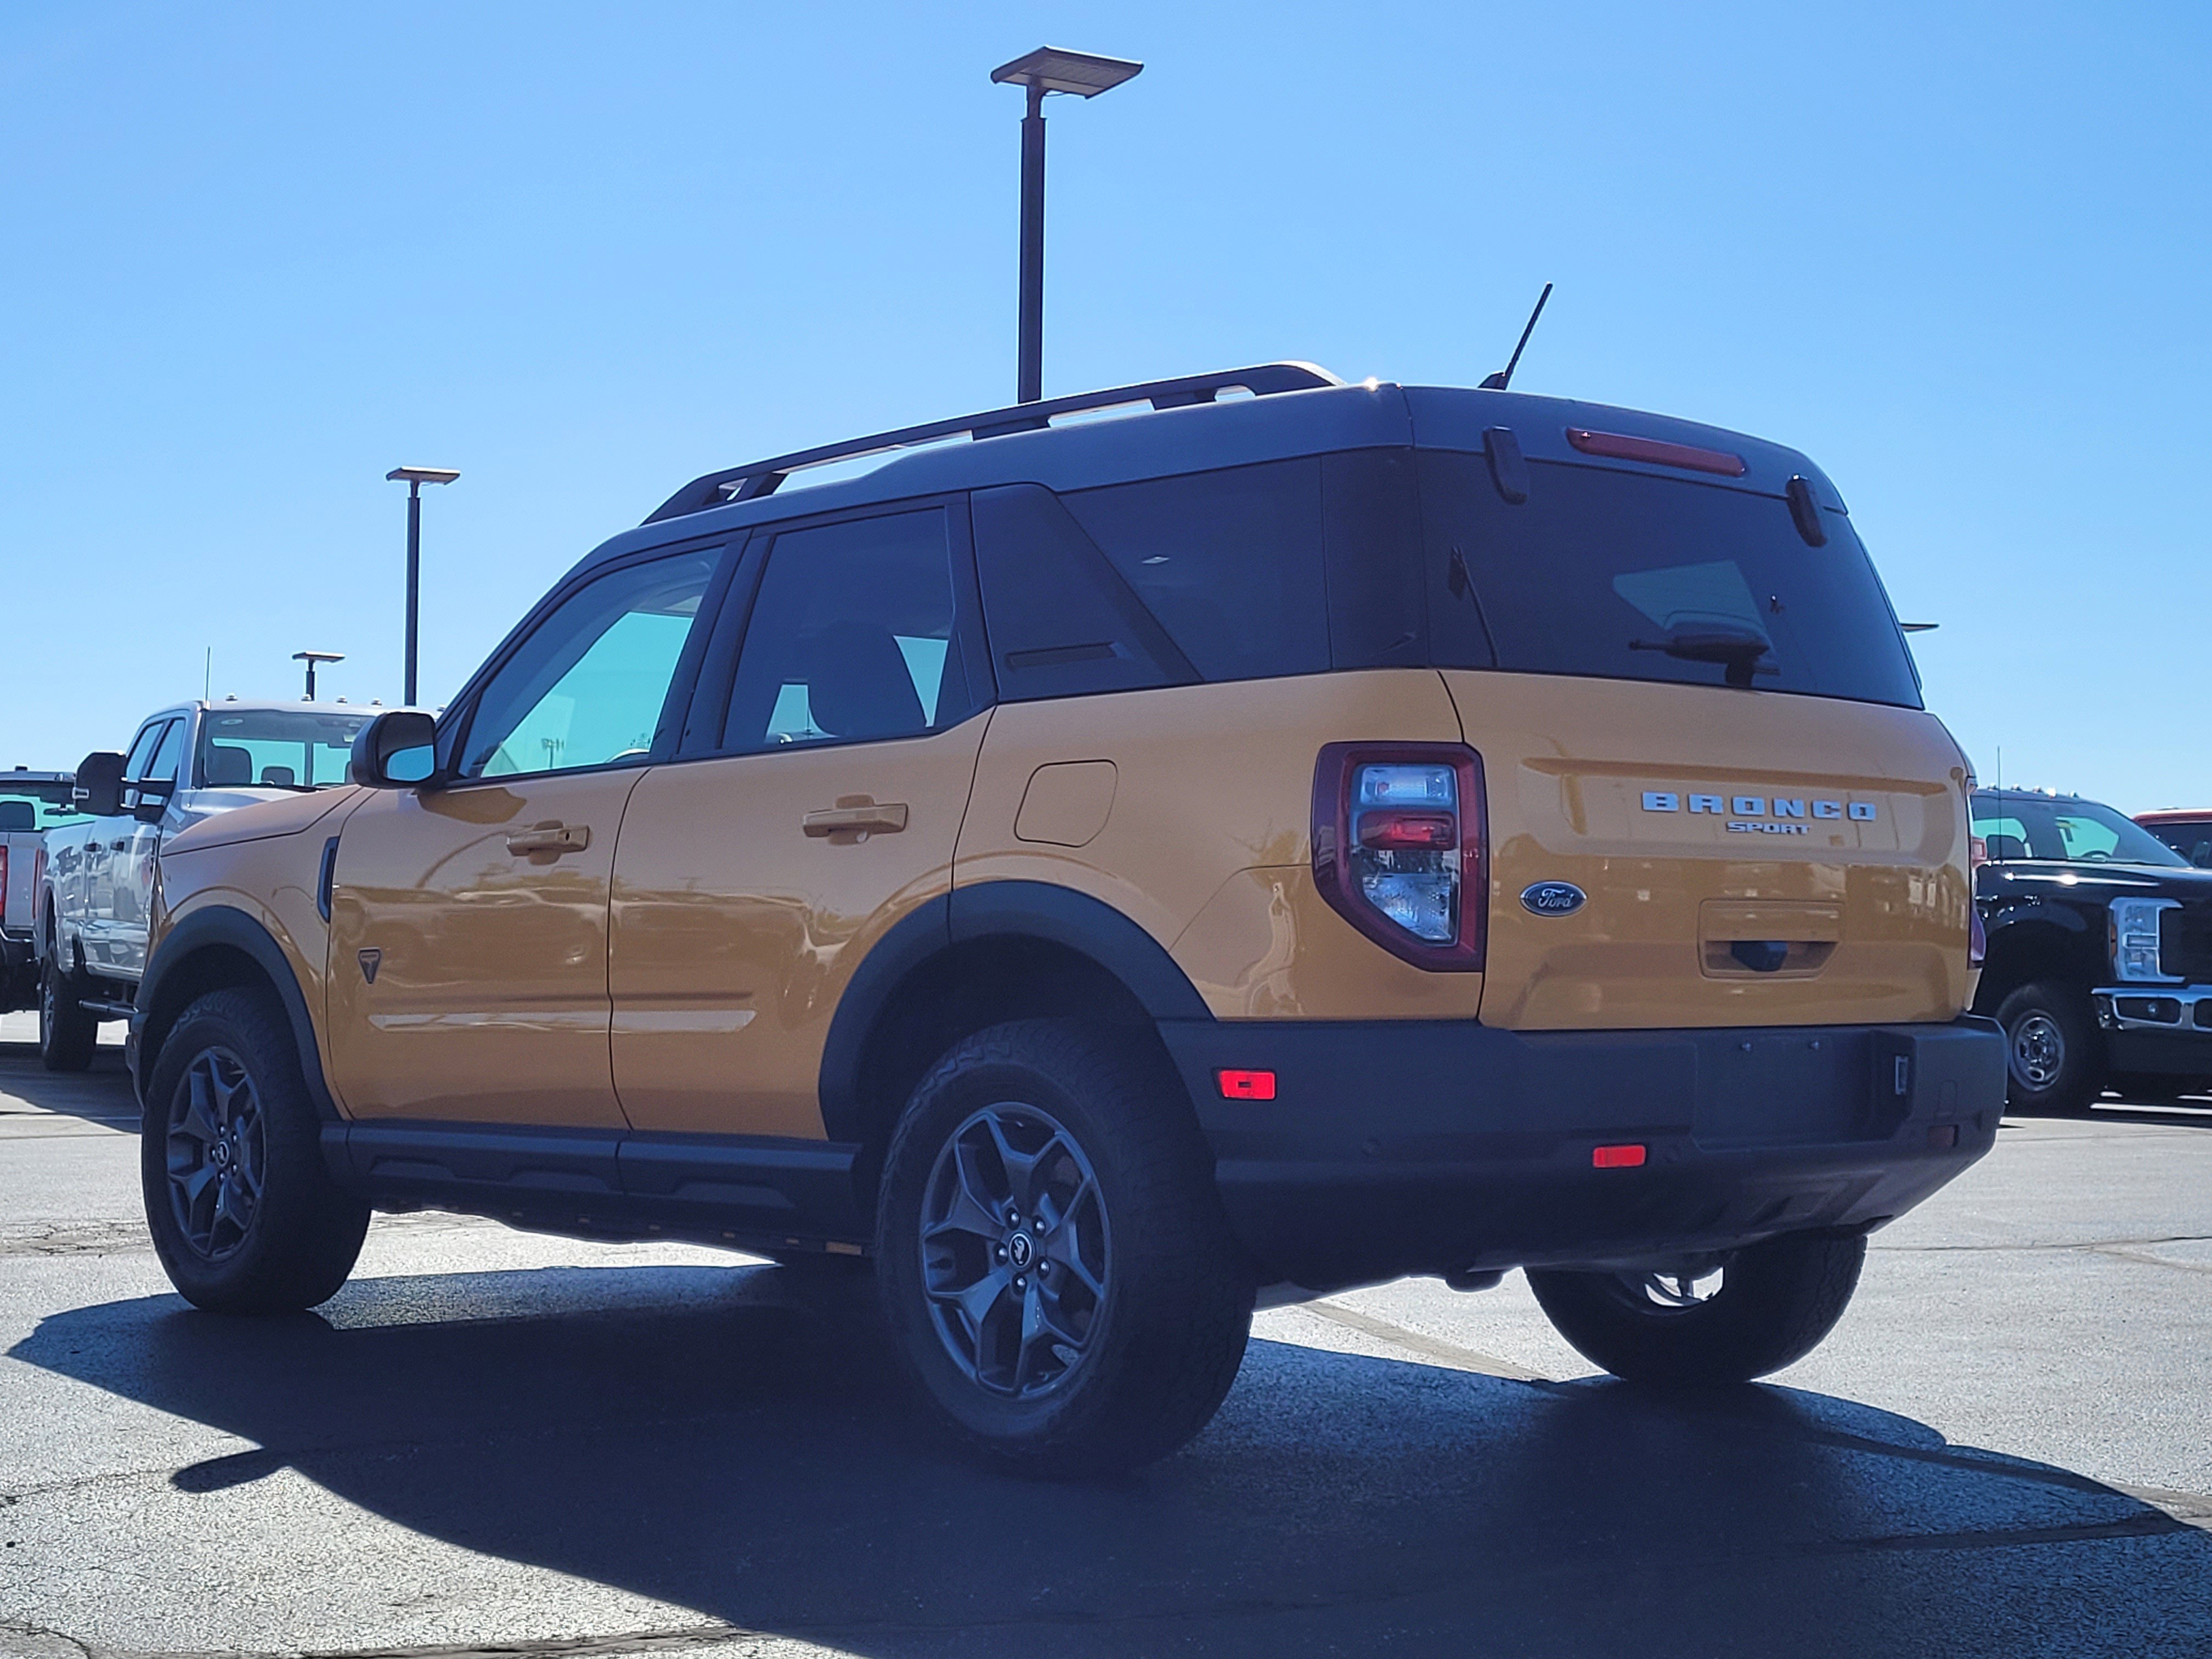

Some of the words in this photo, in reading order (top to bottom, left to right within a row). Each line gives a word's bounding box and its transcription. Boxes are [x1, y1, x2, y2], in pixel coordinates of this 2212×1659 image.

[1641, 791, 1876, 821] BRONCO
[1727, 821, 1810, 835] SPORT
[1538, 888, 1574, 908] Ford
